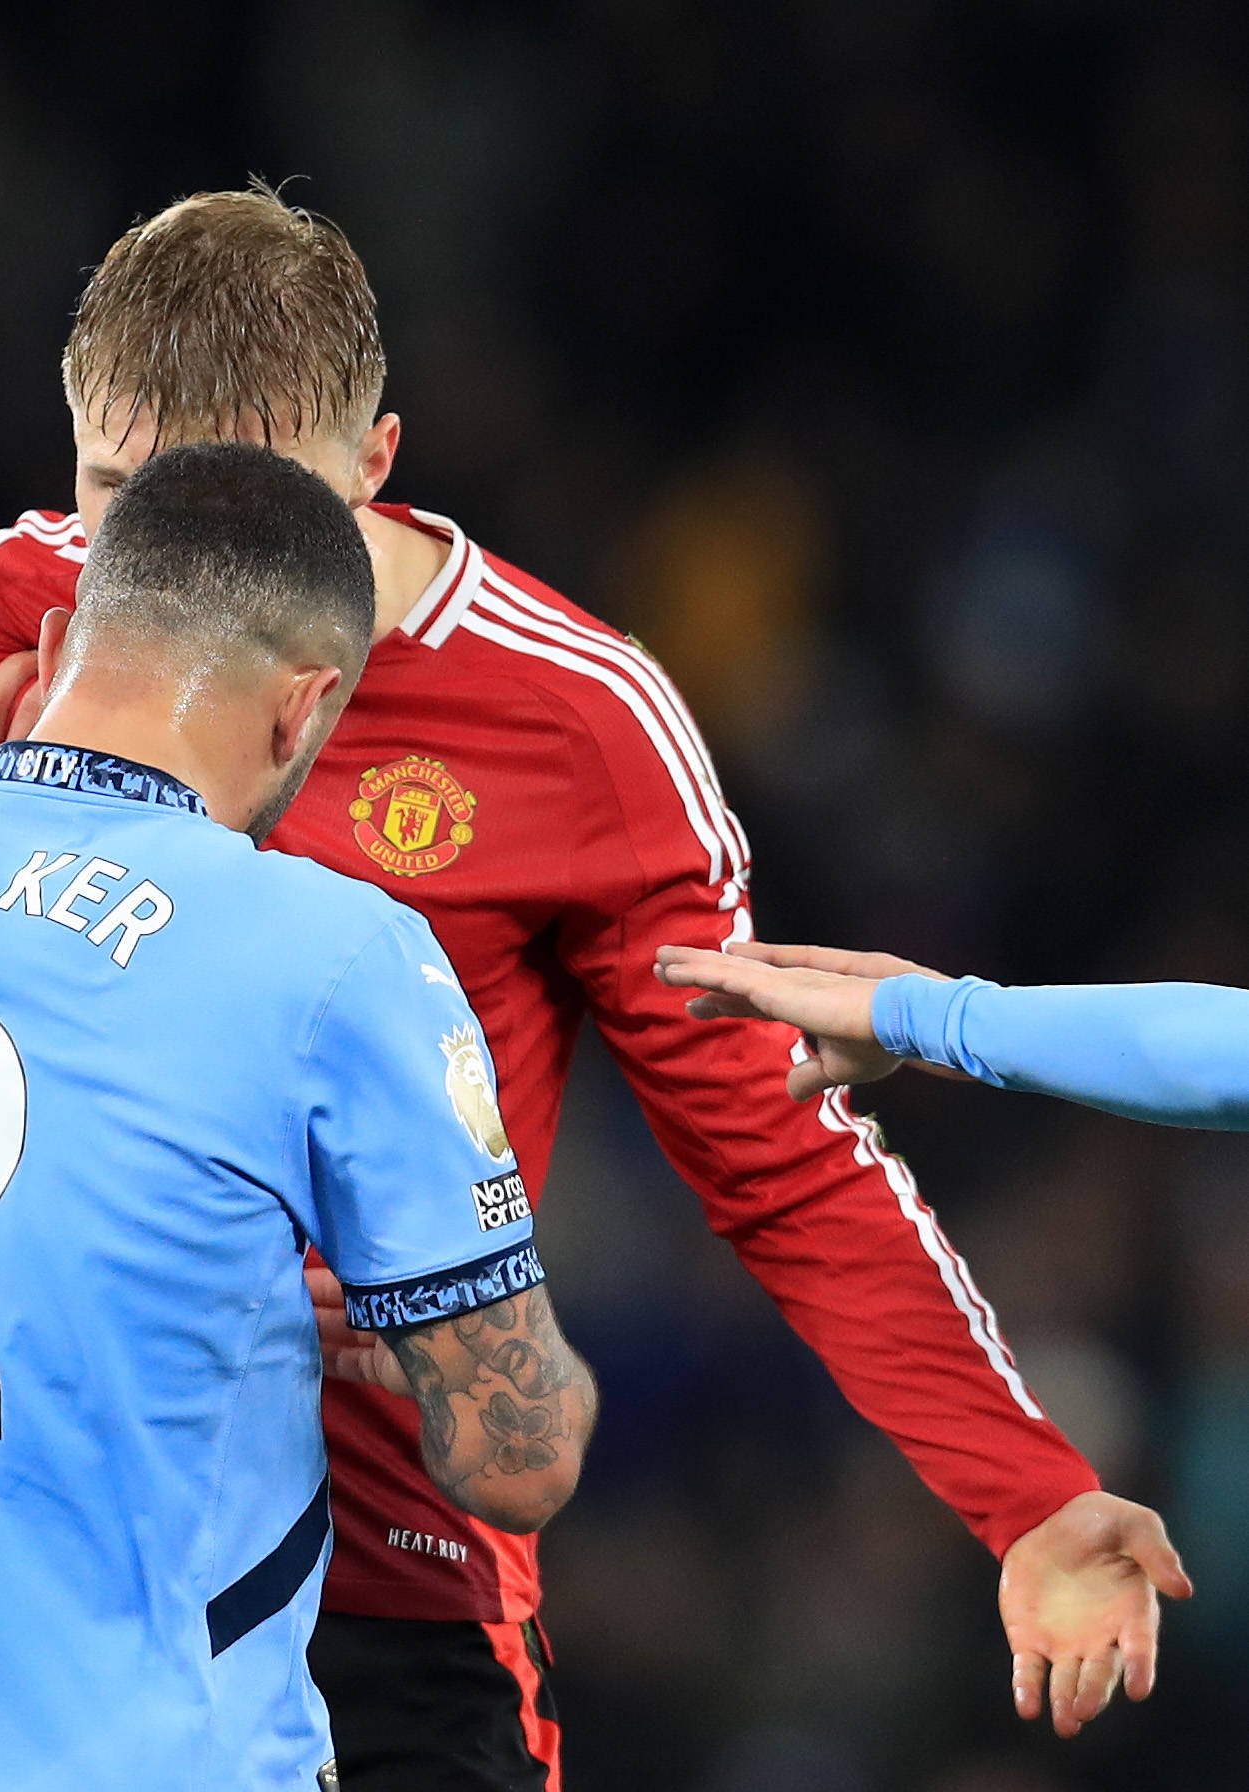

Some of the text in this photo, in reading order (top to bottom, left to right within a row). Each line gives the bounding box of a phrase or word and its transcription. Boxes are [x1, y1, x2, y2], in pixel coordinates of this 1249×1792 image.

[17, 748, 79, 783] CITY
[369, 764, 466, 814] MANCHESTER
[370, 840, 439, 869] UNITED
[470, 1180, 504, 1207] No
[478, 1203, 508, 1232] for
